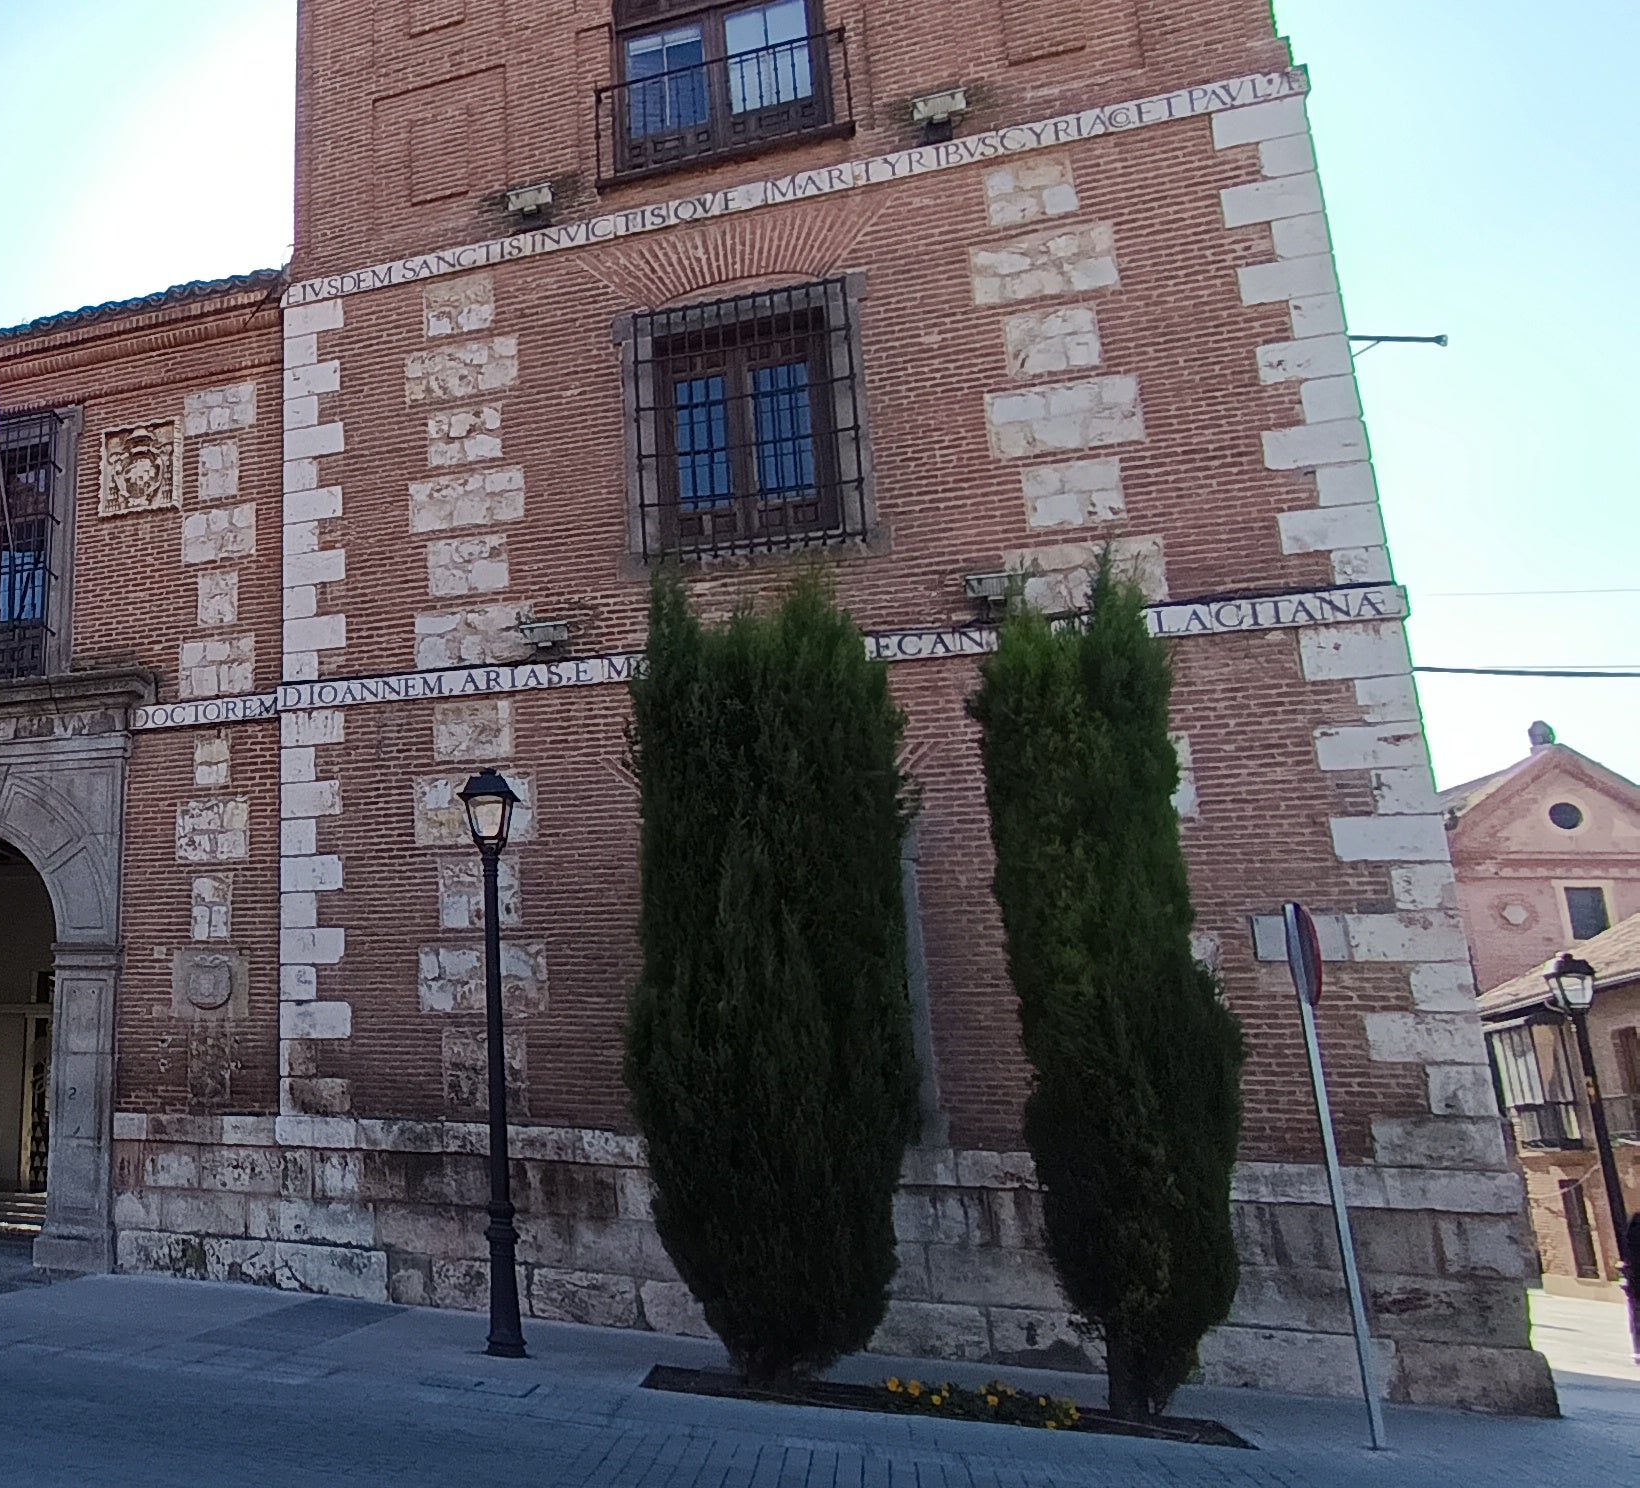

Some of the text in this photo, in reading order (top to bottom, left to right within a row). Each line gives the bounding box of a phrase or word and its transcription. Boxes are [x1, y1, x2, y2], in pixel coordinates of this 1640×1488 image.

[286, 265, 392, 306] EIVSDEM
[401, 238, 523, 279] SANCTIS
[1134, 94, 1182, 124] ET
[132, 696, 279, 728] DOCTOREM
